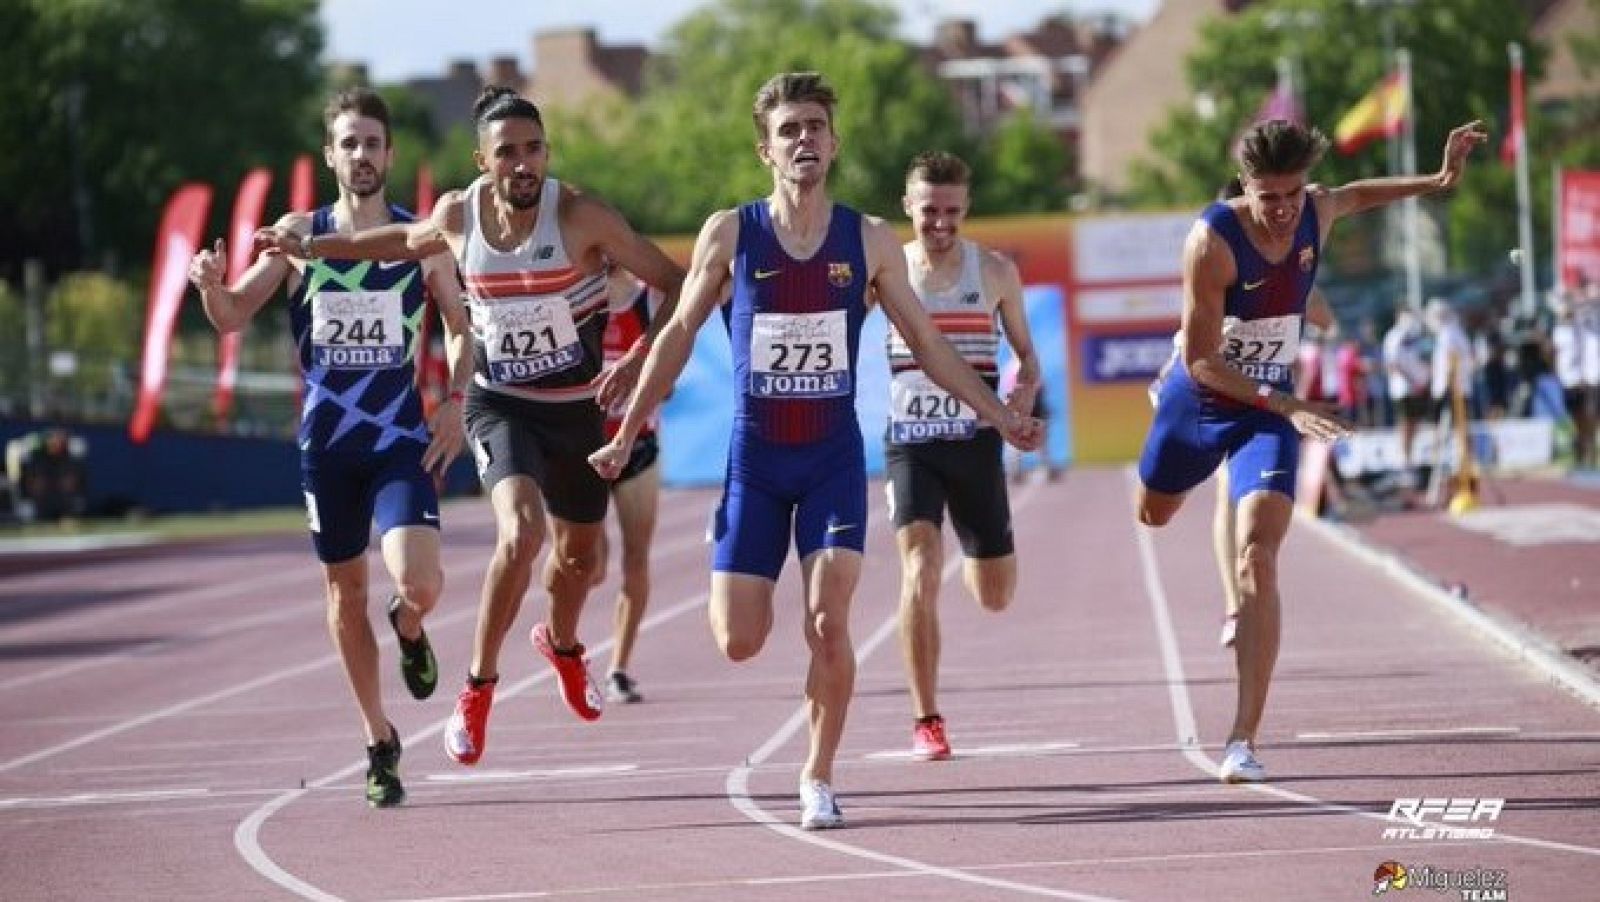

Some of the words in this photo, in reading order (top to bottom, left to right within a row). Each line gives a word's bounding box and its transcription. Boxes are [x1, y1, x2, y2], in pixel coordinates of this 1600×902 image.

[326, 318, 387, 345] 244
[500, 325, 558, 358] 421
[319, 347, 394, 366] Joma
[770, 343, 833, 371] 273
[1224, 338, 1284, 361] 327
[494, 350, 573, 381] Joma
[761, 373, 838, 394] Joma
[907, 395, 961, 419] 420
[901, 420, 969, 440] Joma
